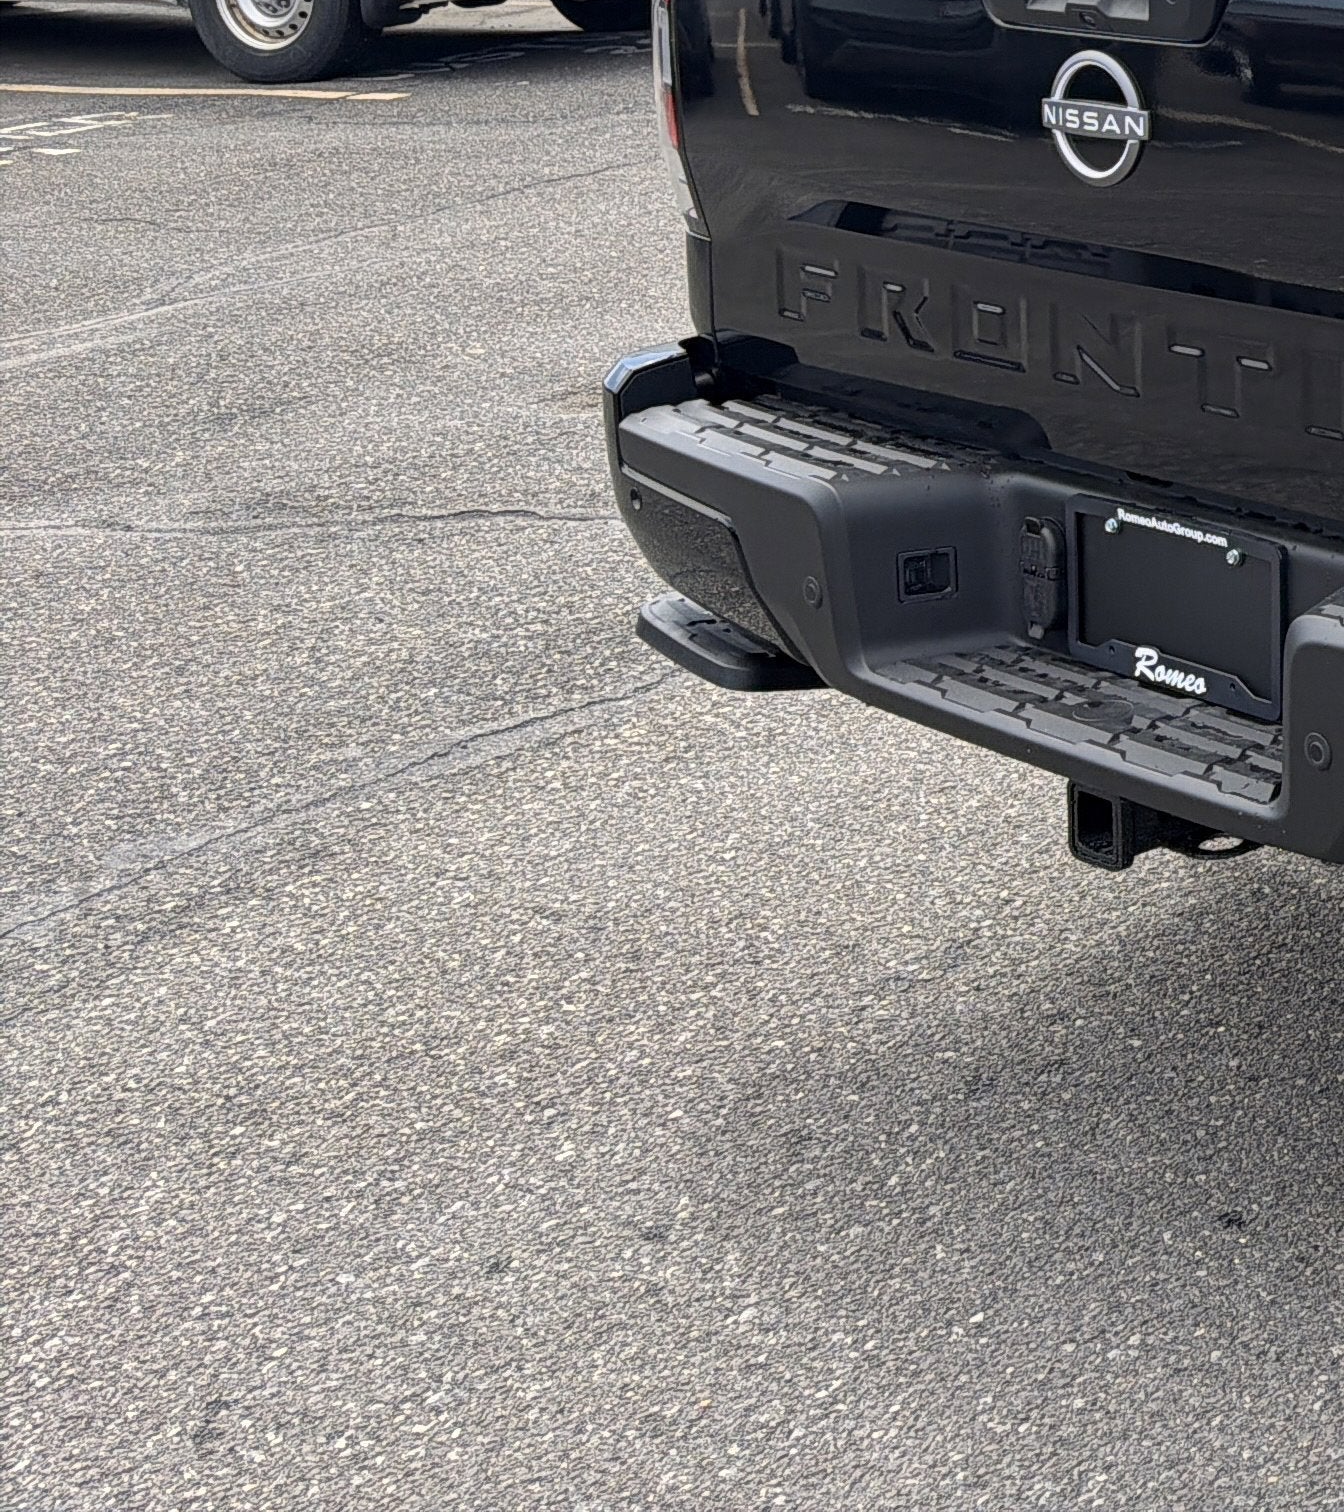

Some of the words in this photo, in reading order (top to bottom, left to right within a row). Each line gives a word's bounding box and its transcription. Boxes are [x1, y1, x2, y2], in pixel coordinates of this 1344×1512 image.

[1043, 103, 1145, 137] NISSAN
[1117, 507, 1228, 548] RomeoAutoGroup.com
[1134, 646, 1207, 694] Romeo
